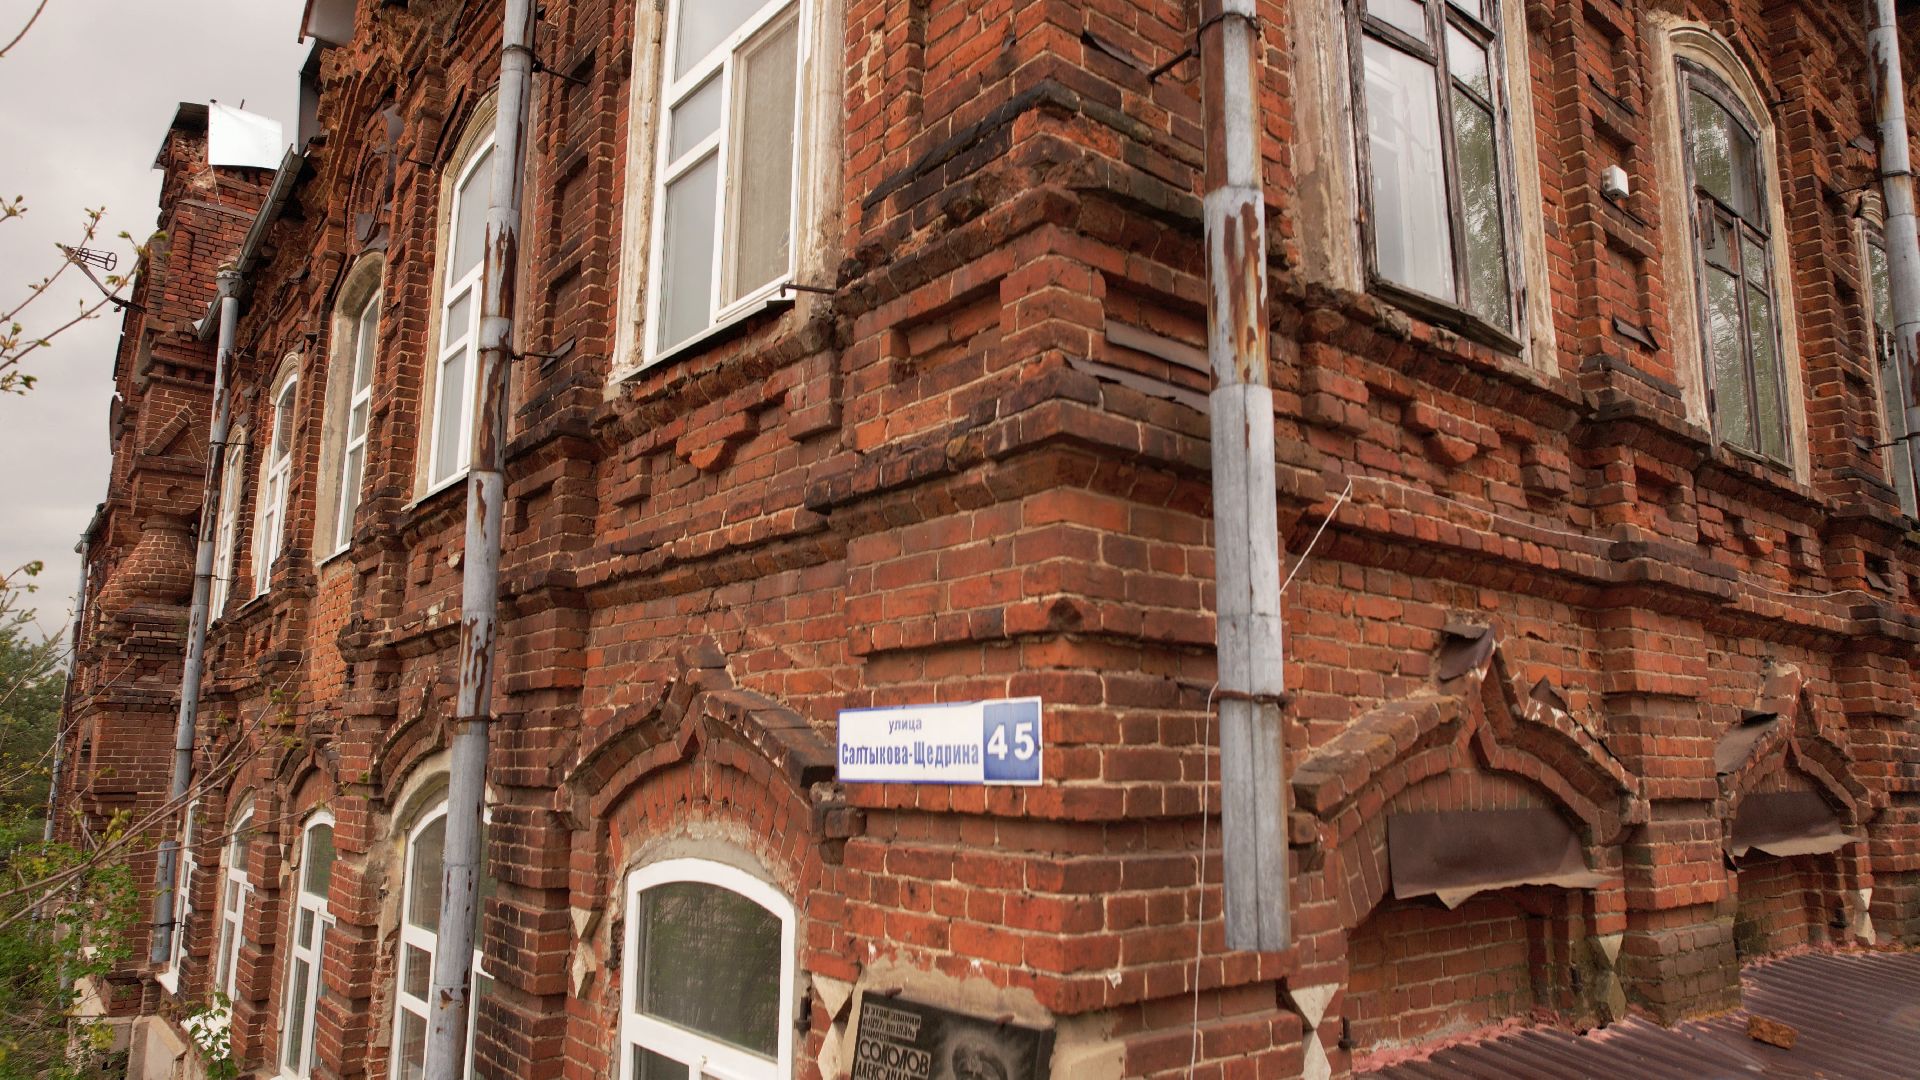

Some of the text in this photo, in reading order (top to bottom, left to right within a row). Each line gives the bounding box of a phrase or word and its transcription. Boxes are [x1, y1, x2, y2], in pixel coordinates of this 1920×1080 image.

[888, 717, 923, 735] улица
[987, 721, 1036, 761] 45
[841, 740, 980, 769] Салтыкова-Щедрина
[859, 1039, 930, 1076] СОКОЛОВ
